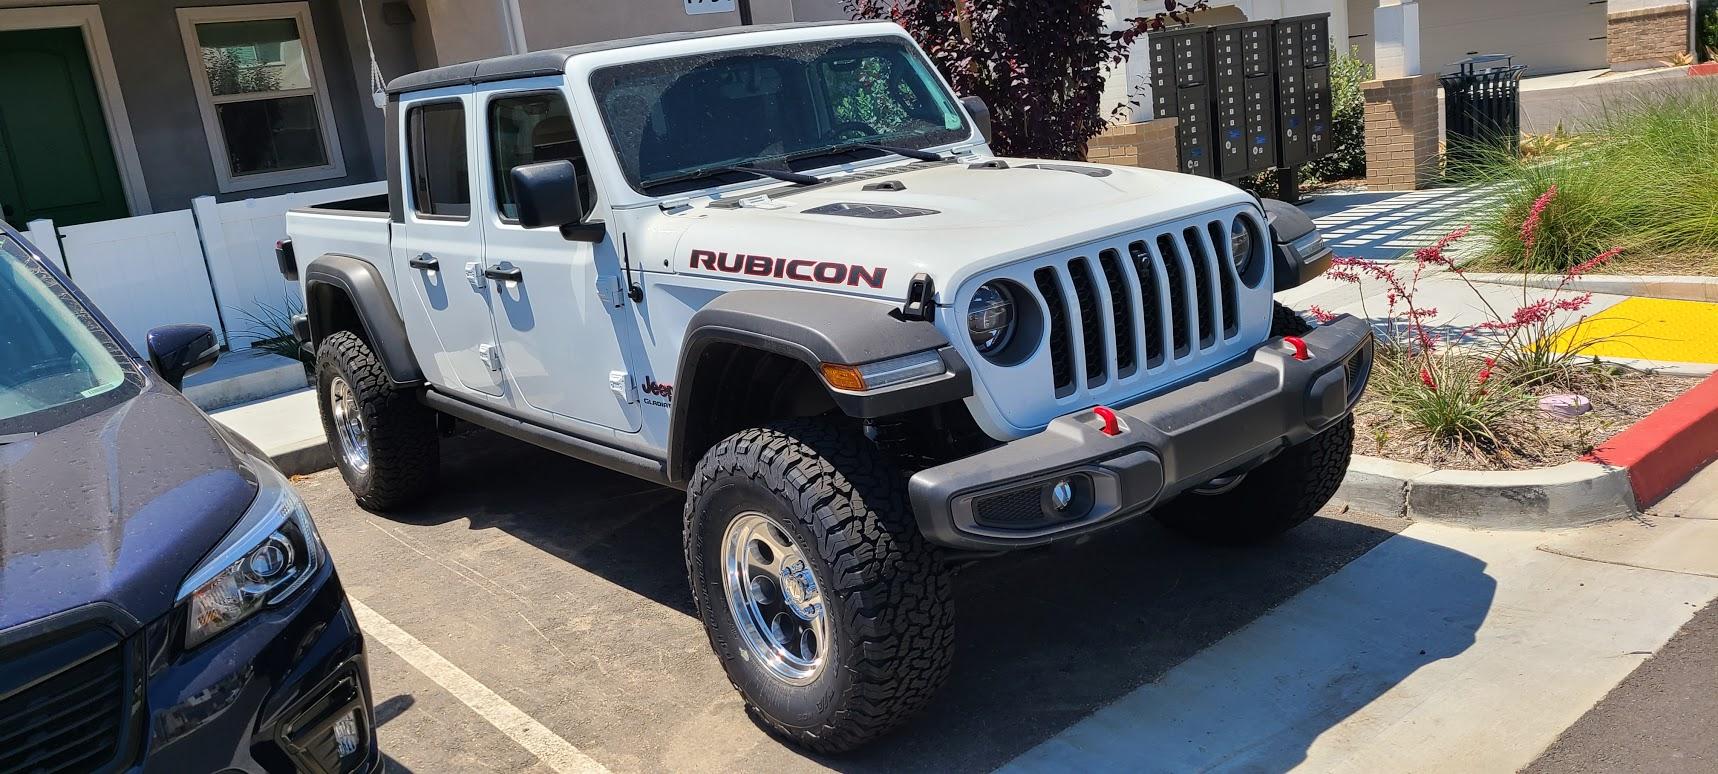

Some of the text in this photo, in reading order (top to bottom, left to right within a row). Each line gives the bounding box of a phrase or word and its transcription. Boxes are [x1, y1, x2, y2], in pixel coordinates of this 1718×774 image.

[689, 249, 888, 289] RUBICON
[641, 375, 673, 402] Jeep
[643, 397, 671, 409] GLADIAT
